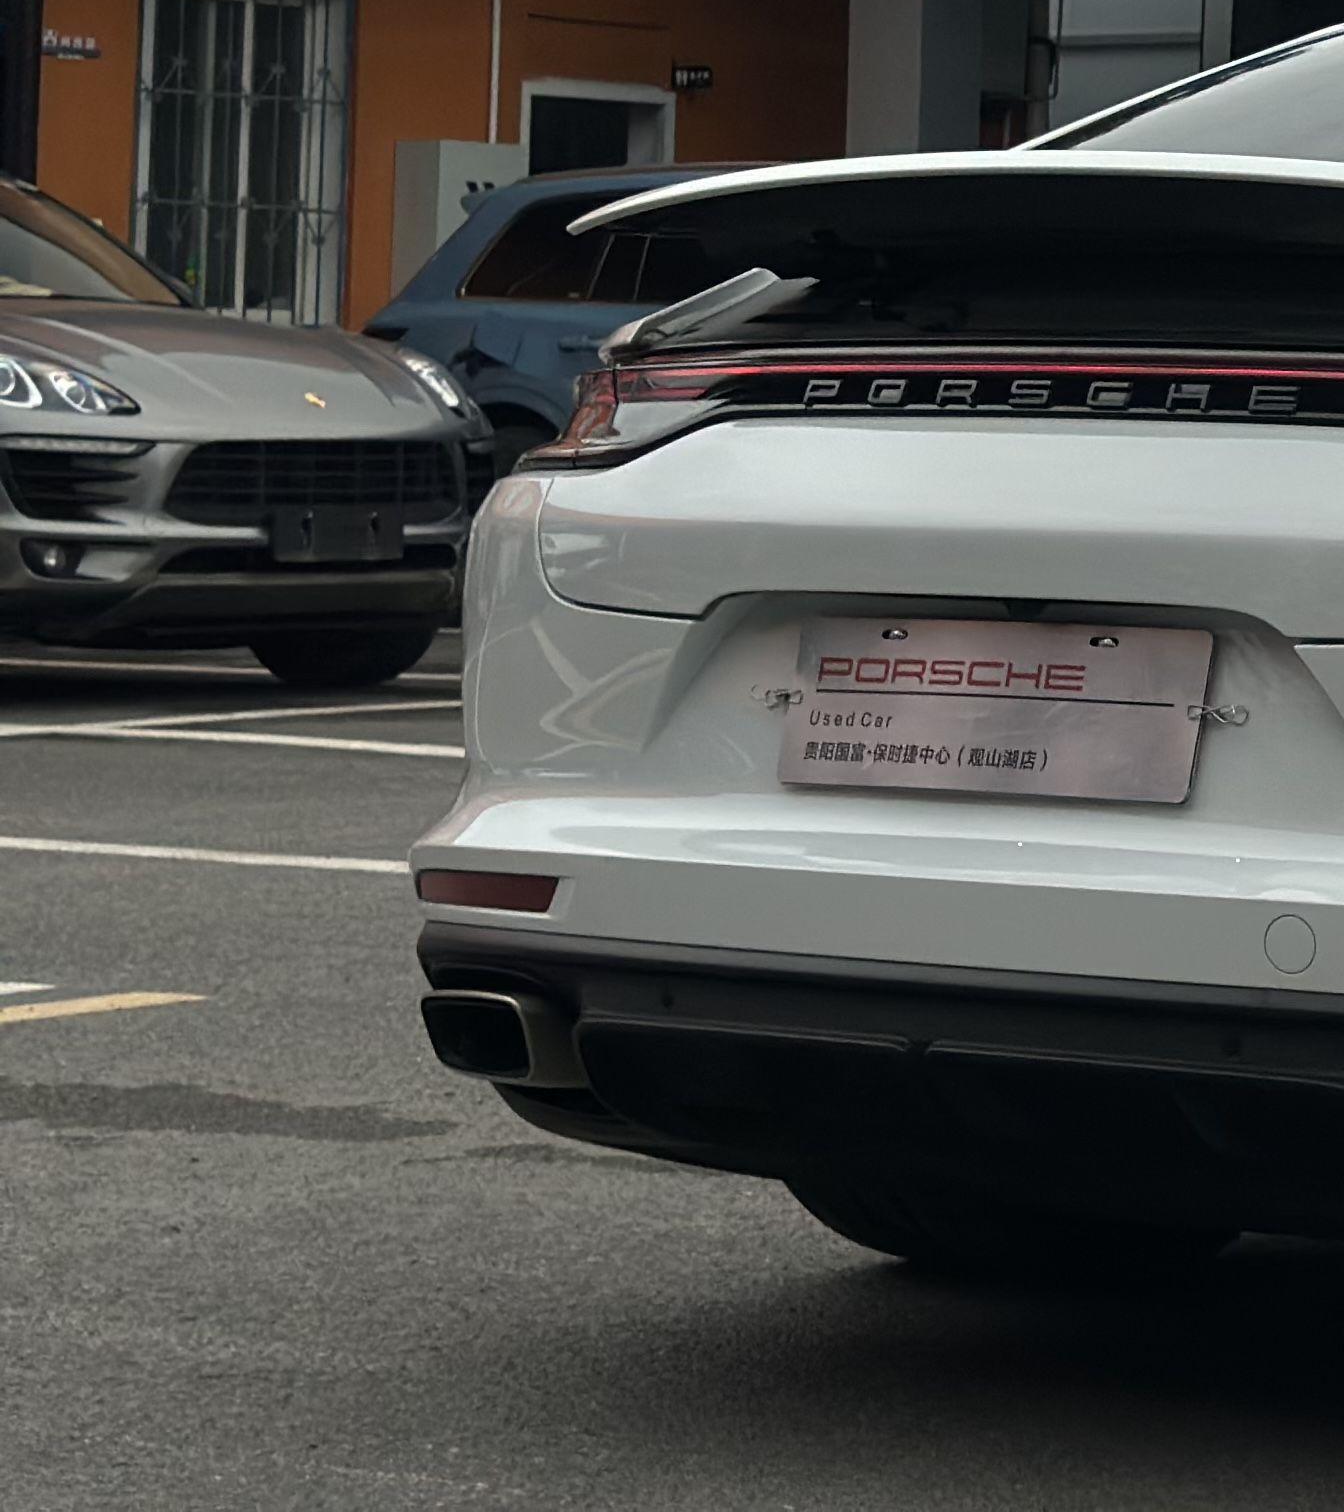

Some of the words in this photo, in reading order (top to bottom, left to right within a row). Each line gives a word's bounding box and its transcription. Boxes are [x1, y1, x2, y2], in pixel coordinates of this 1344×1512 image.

[802, 379, 1298, 416] PORSCHE
[816, 656, 1087, 692] PORSCHE
[808, 710, 856, 728] Used
[860, 711, 894, 729] Car
